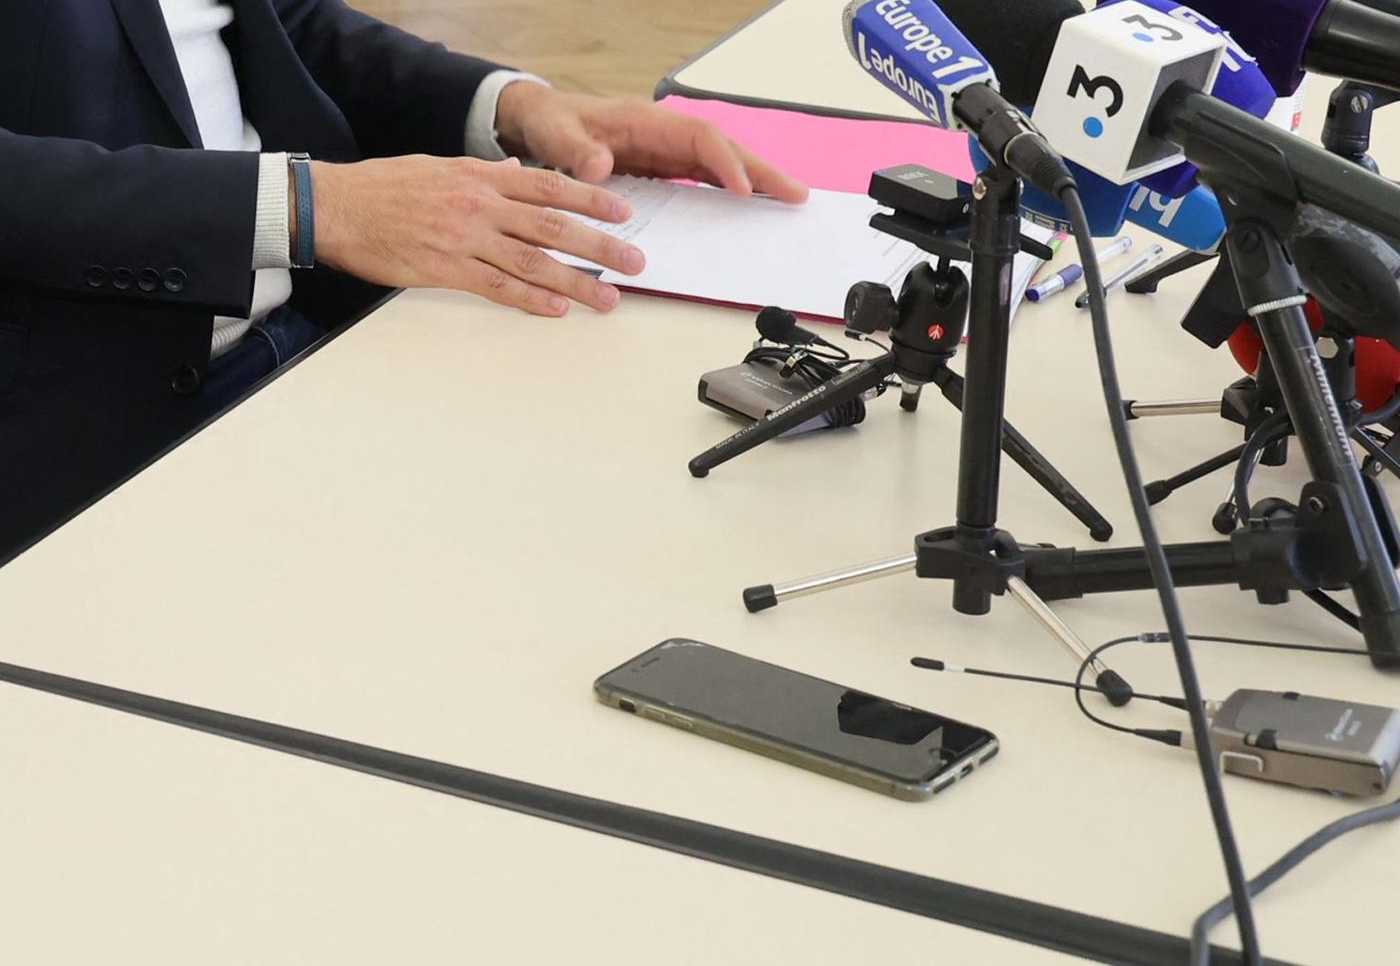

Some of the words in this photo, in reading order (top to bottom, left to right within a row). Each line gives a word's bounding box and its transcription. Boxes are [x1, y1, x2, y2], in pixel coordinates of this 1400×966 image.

[1121, 14, 1184, 41] 3
[870, 48, 942, 124] Europe
[932, 55, 984, 80] 1
[1066, 64, 1124, 118] 3
[766, 384, 827, 422] Manfrotto
